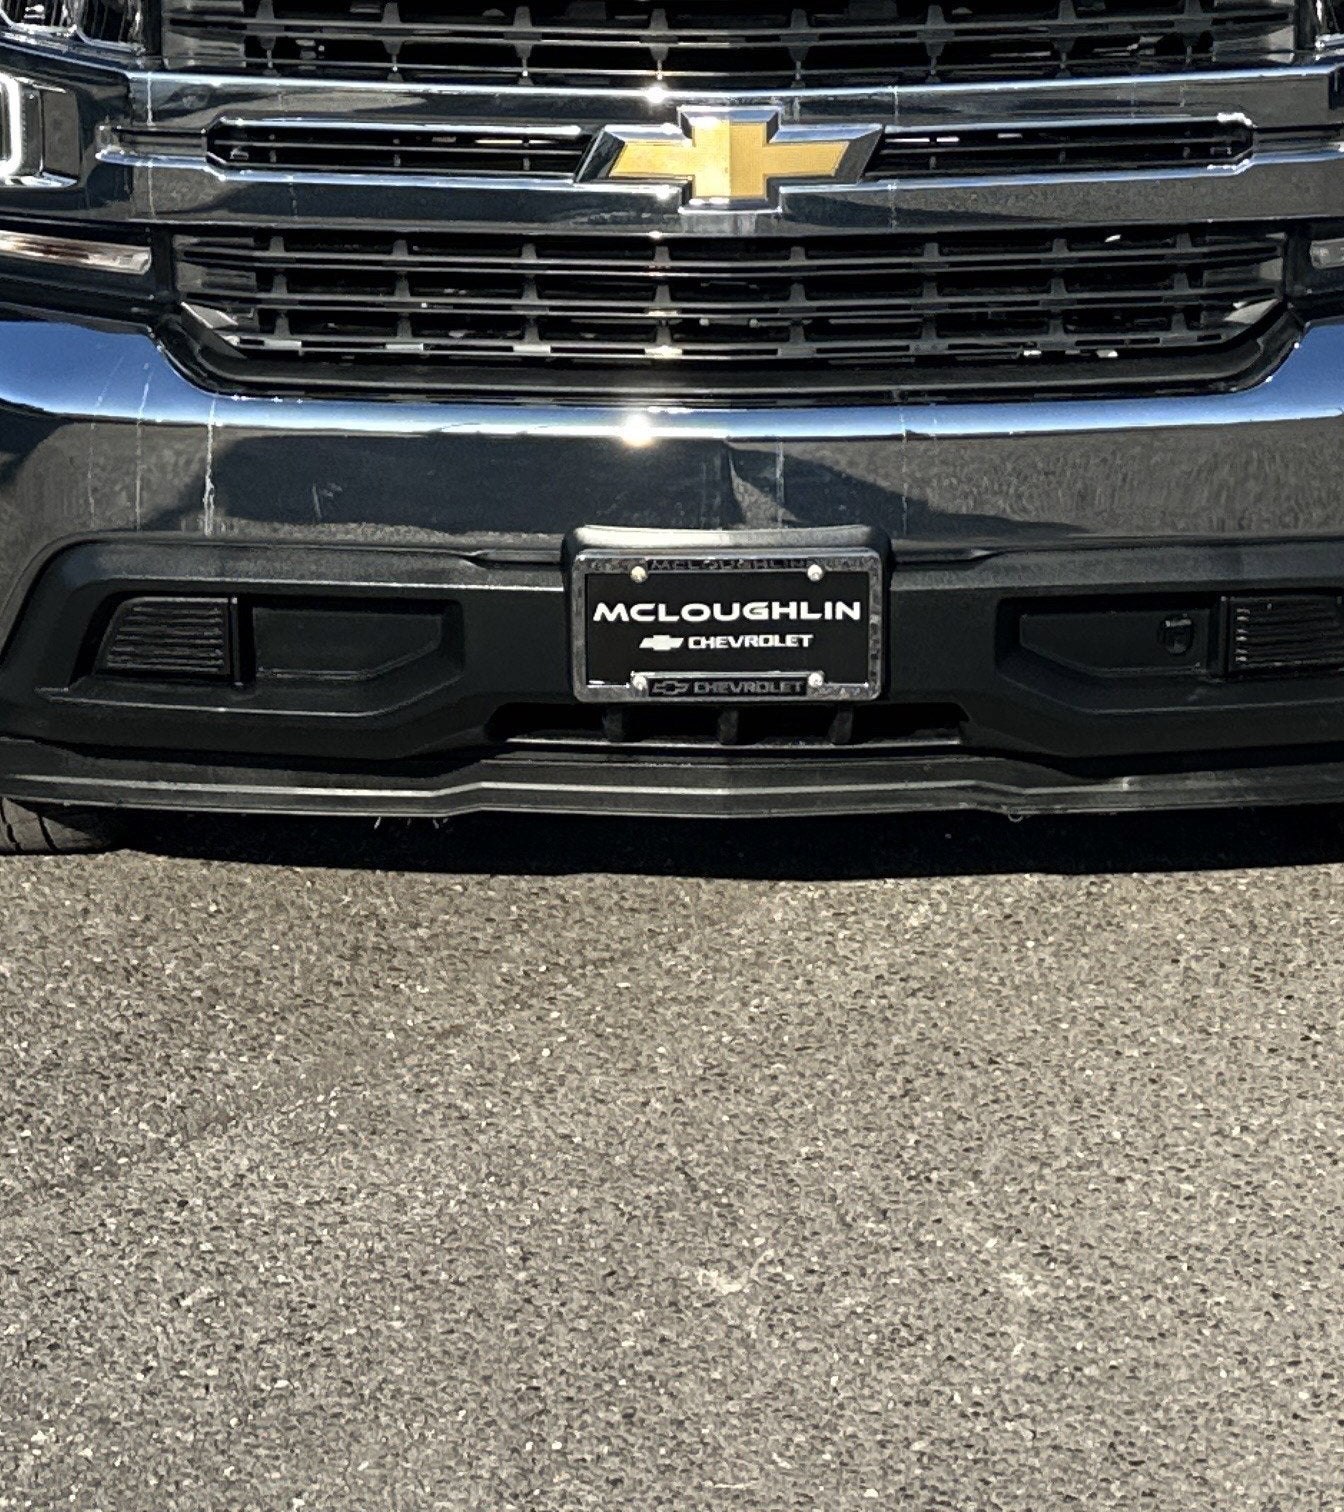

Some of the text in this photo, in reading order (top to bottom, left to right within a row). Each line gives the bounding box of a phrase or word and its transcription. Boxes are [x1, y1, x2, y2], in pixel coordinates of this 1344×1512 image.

[592, 601, 861, 622] MCLOUGHLIN
[688, 634, 814, 649] CHEVROLET
[694, 681, 803, 694] CHEVROLET
